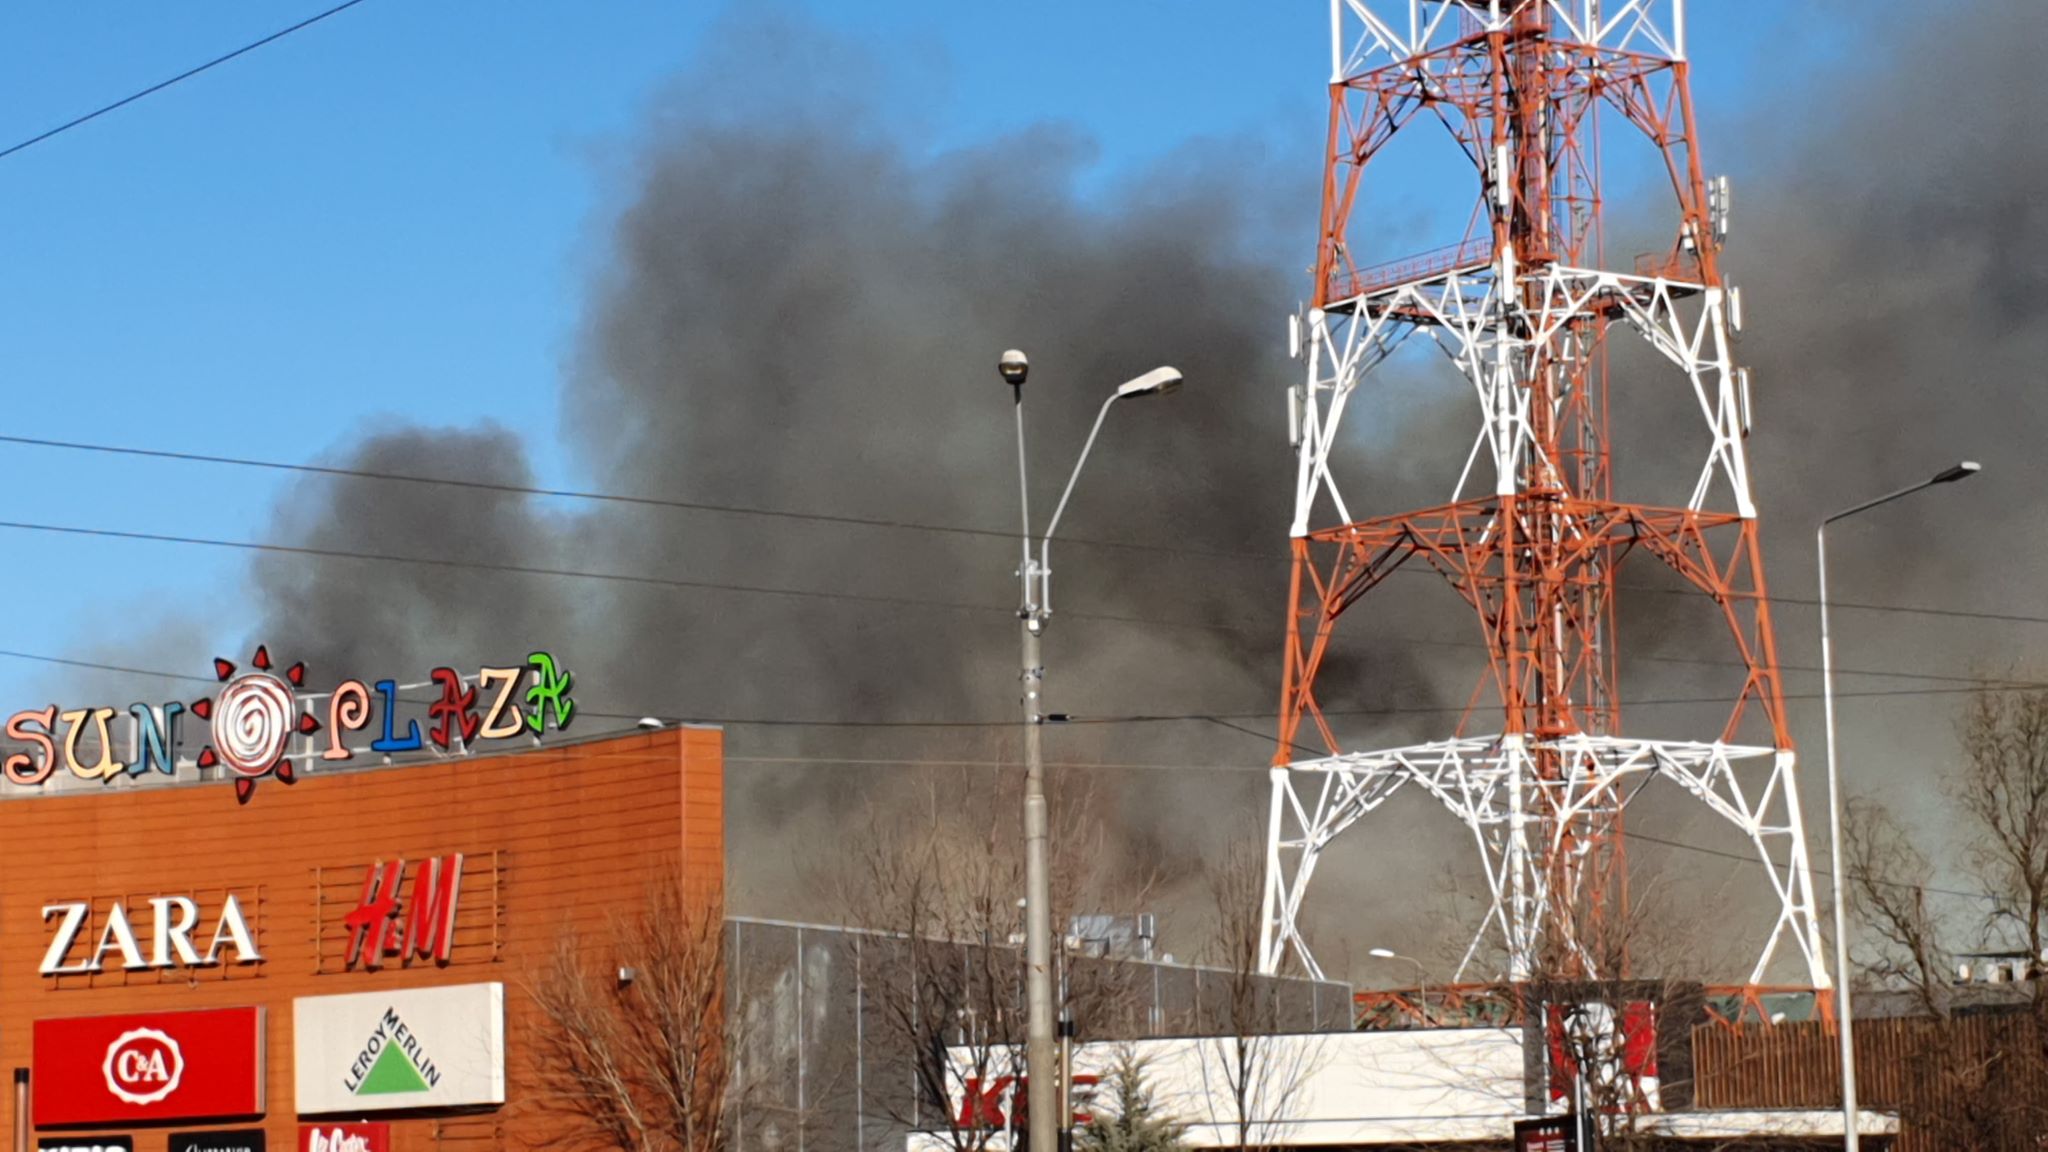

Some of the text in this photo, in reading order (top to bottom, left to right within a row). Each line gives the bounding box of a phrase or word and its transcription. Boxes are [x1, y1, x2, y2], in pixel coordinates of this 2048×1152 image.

[4, 652, 574, 784] SUN PLAZA
[39, 894, 262, 974] ZARA
[344, 852, 463, 970] H&M
[117, 1048, 169, 1083] C&A
[343, 1006, 441, 1092] LEROY MERLIN
[957, 1074, 1099, 1127] KC
